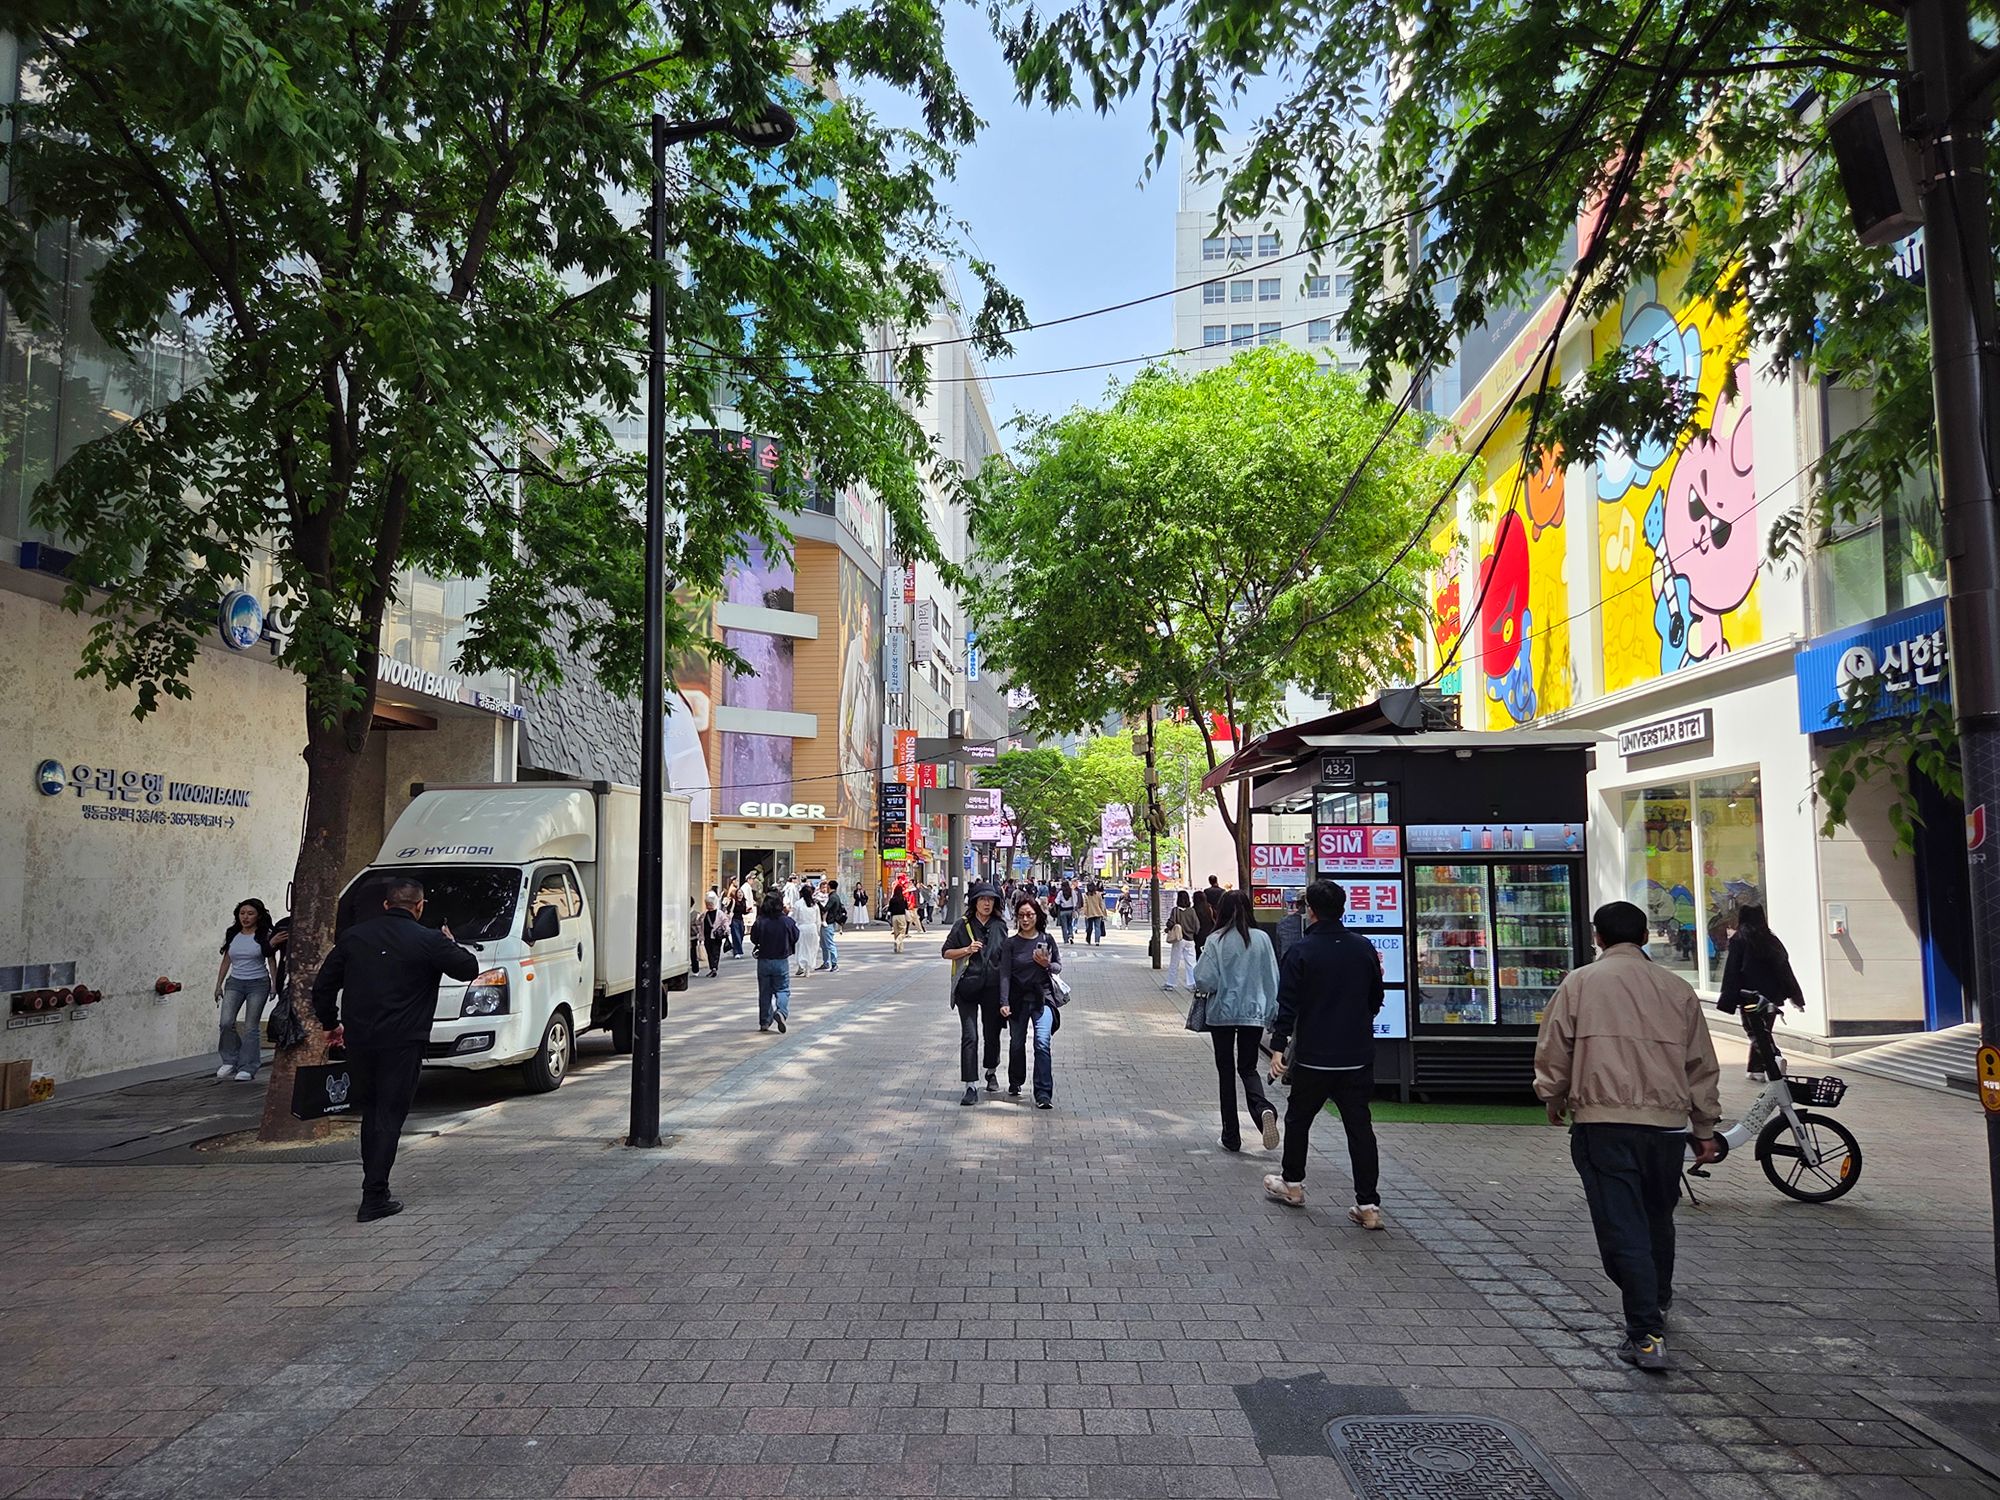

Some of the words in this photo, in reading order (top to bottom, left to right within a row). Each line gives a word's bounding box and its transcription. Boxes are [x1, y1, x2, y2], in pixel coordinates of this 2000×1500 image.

[1880, 631, 1949, 692] 신한
[377, 656, 424, 692] WOORI
[424, 671, 463, 703] BANK
[1621, 723, 1677, 752] UNIVERSTAR
[1678, 716, 1701, 740] BT21
[905, 736, 915, 782] SUNSKIN
[1325, 763, 1352, 776] 43-2
[68, 764, 165, 805] 우리은행
[169, 781, 216, 805] WOORI
[216, 787, 253, 808] BANK
[82, 804, 135, 822] 명동금융센터
[739, 801, 826, 818] EIDER
[424, 846, 494, 856] HYUNDAI
[1320, 834, 1362, 854] SIM
[1254, 846, 1293, 866] SIM
[1254, 893, 1281, 904] eSIM
[1341, 886, 1398, 911] 품권
